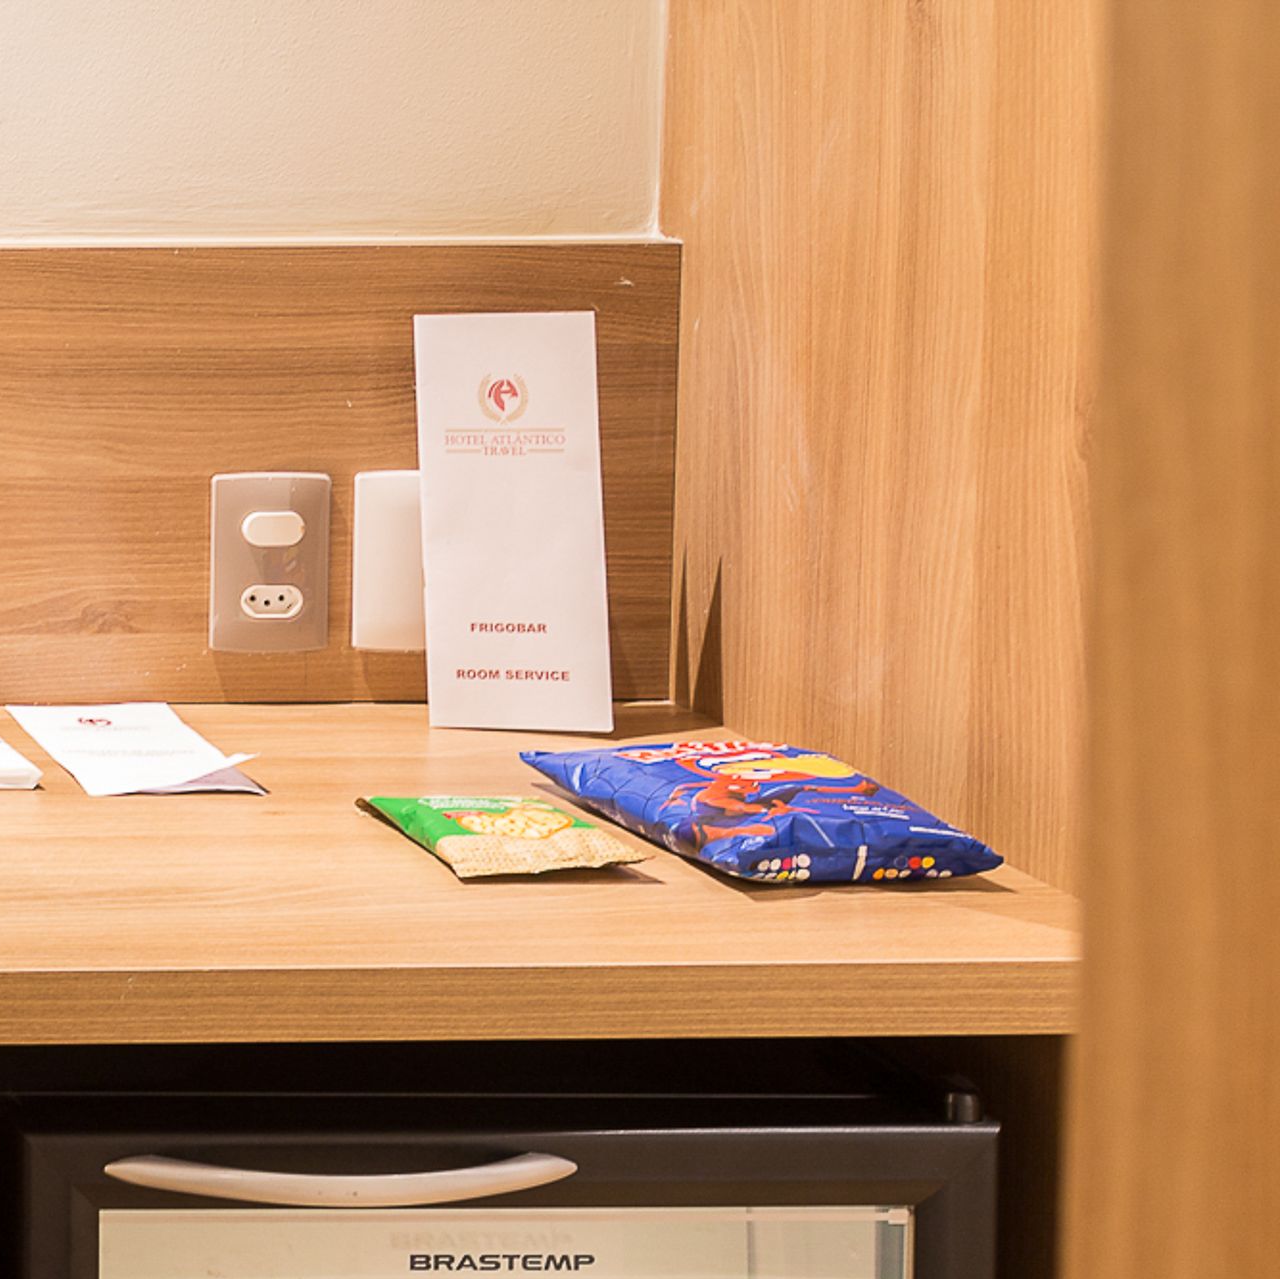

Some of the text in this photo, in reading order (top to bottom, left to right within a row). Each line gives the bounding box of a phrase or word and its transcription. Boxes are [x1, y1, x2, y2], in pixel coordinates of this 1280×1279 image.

[445, 434, 487, 446] HOTEL
[469, 622, 548, 633] FRIGOBAR
[456, 668, 571, 681] ROOM SERVICE
[409, 1253, 595, 1271] BRASTEMP
